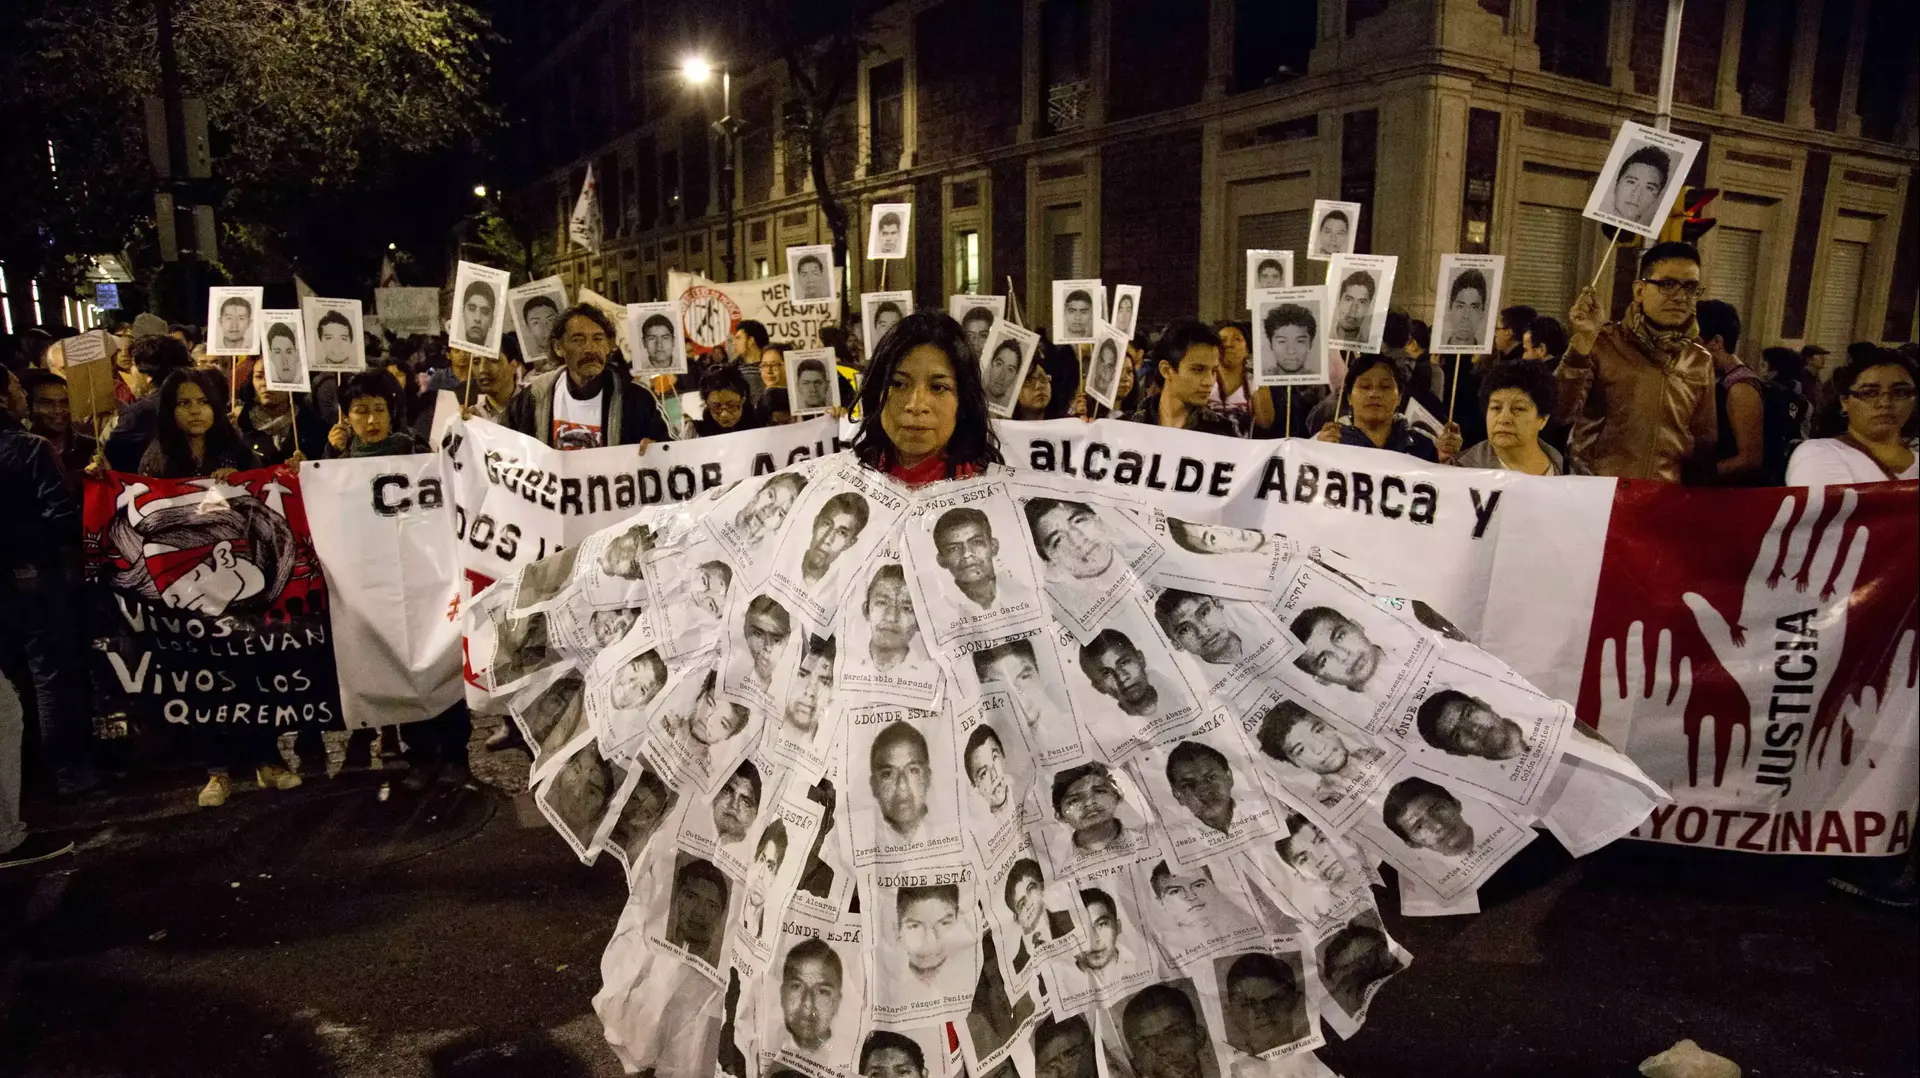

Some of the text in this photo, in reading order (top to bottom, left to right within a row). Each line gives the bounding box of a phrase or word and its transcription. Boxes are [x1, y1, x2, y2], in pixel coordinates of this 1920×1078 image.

[1468, 486, 1504, 540] Y
[1078, 596, 1107, 625] Antonio
[209, 624, 326, 656] LLEVAN
[1756, 607, 1819, 797] JUSTICIA
[854, 710, 903, 726] ¿DÓNDE
[1630, 804, 1910, 855] YOTZINAPA
[877, 868, 972, 888] ¿DÓNDE ESTÁ?
[780, 1055, 816, 1077] Ayotzinapa,
[794, 1052, 836, 1077] desaparecido
